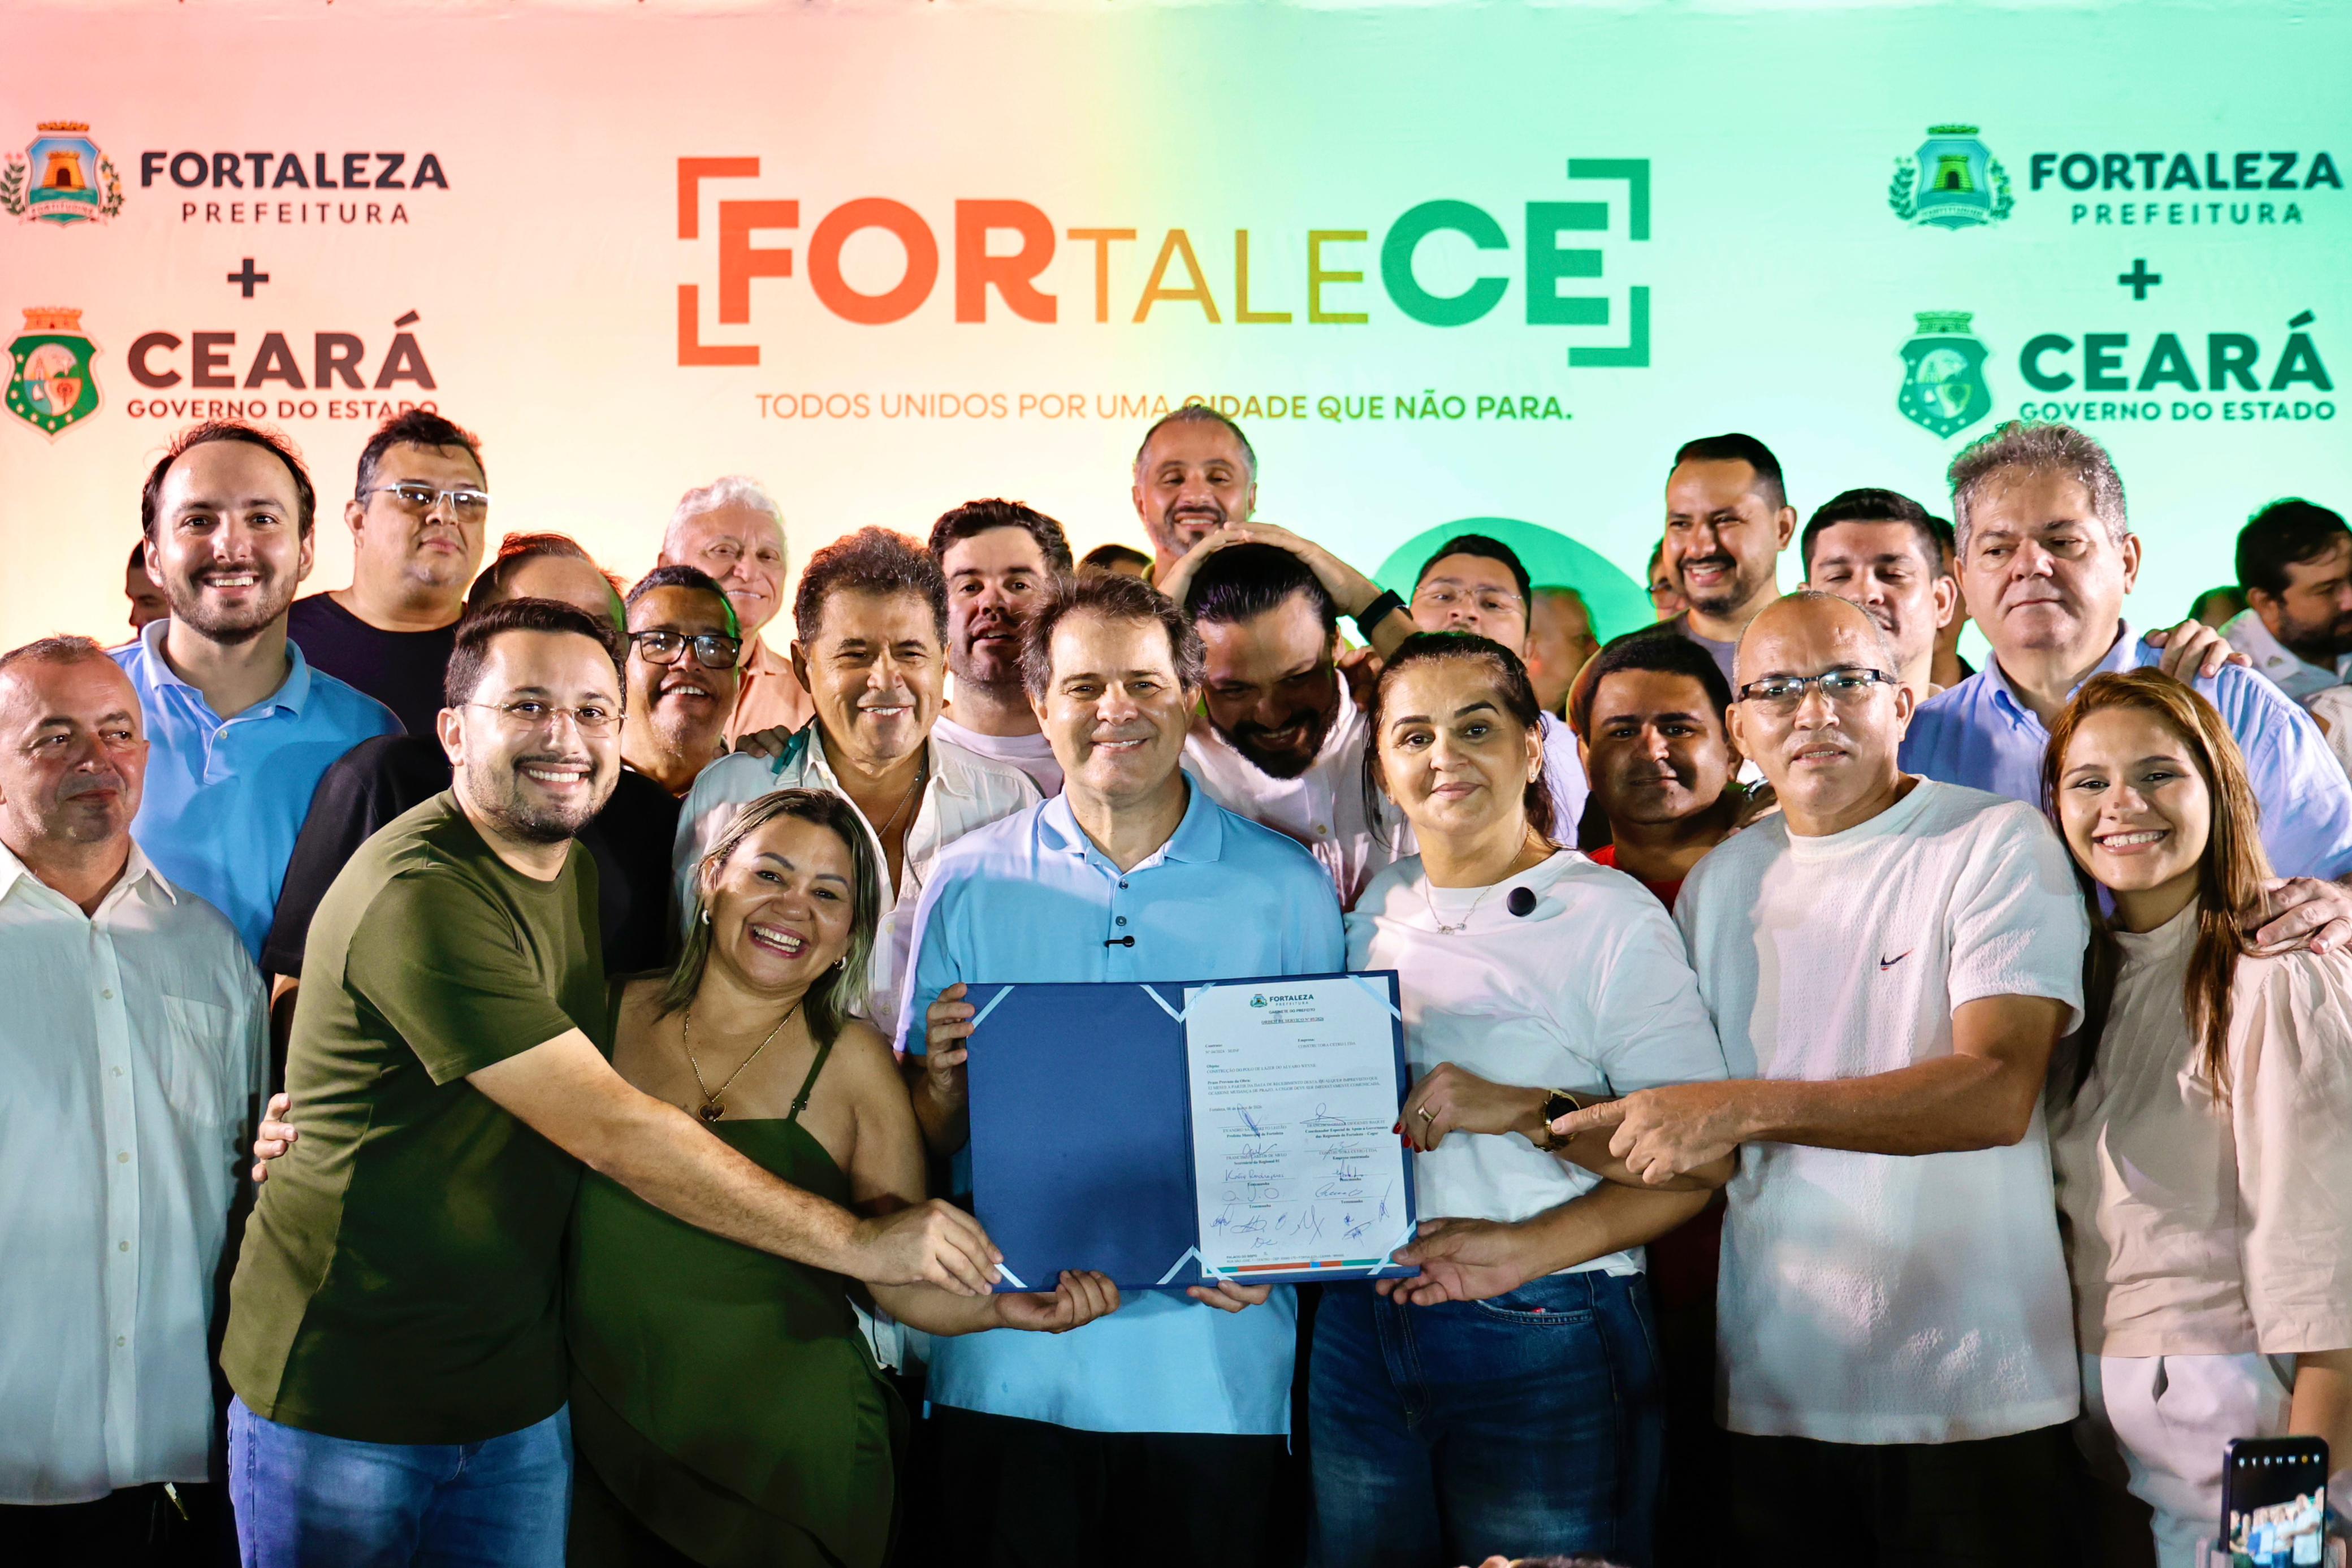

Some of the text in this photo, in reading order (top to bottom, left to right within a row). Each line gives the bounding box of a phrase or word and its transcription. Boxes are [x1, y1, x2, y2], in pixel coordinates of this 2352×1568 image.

[141, 151, 449, 189] FORTALEZA
[2030, 152, 2343, 190] FORTALEZA
[183, 202, 409, 224] PREFEITURA
[2072, 203, 2303, 224] PREFEITURA
[127, 310, 436, 389] CEARÁ
[2020, 309, 2334, 392] CEARÁ
[127, 399, 267, 418] GOVERNO
[278, 400, 318, 418] DO
[755, 394, 870, 418] TODOS
[881, 394, 1008, 418] UNIDOS
[1019, 394, 1086, 418] POR
[1097, 395, 1169, 419] UMA
[1318, 396, 1383, 422] QUE
[1395, 389, 1465, 419] NÃO
[1477, 396, 1573, 419] PARA.
[2020, 402, 2335, 420] GOVERNO DO ESTADO
